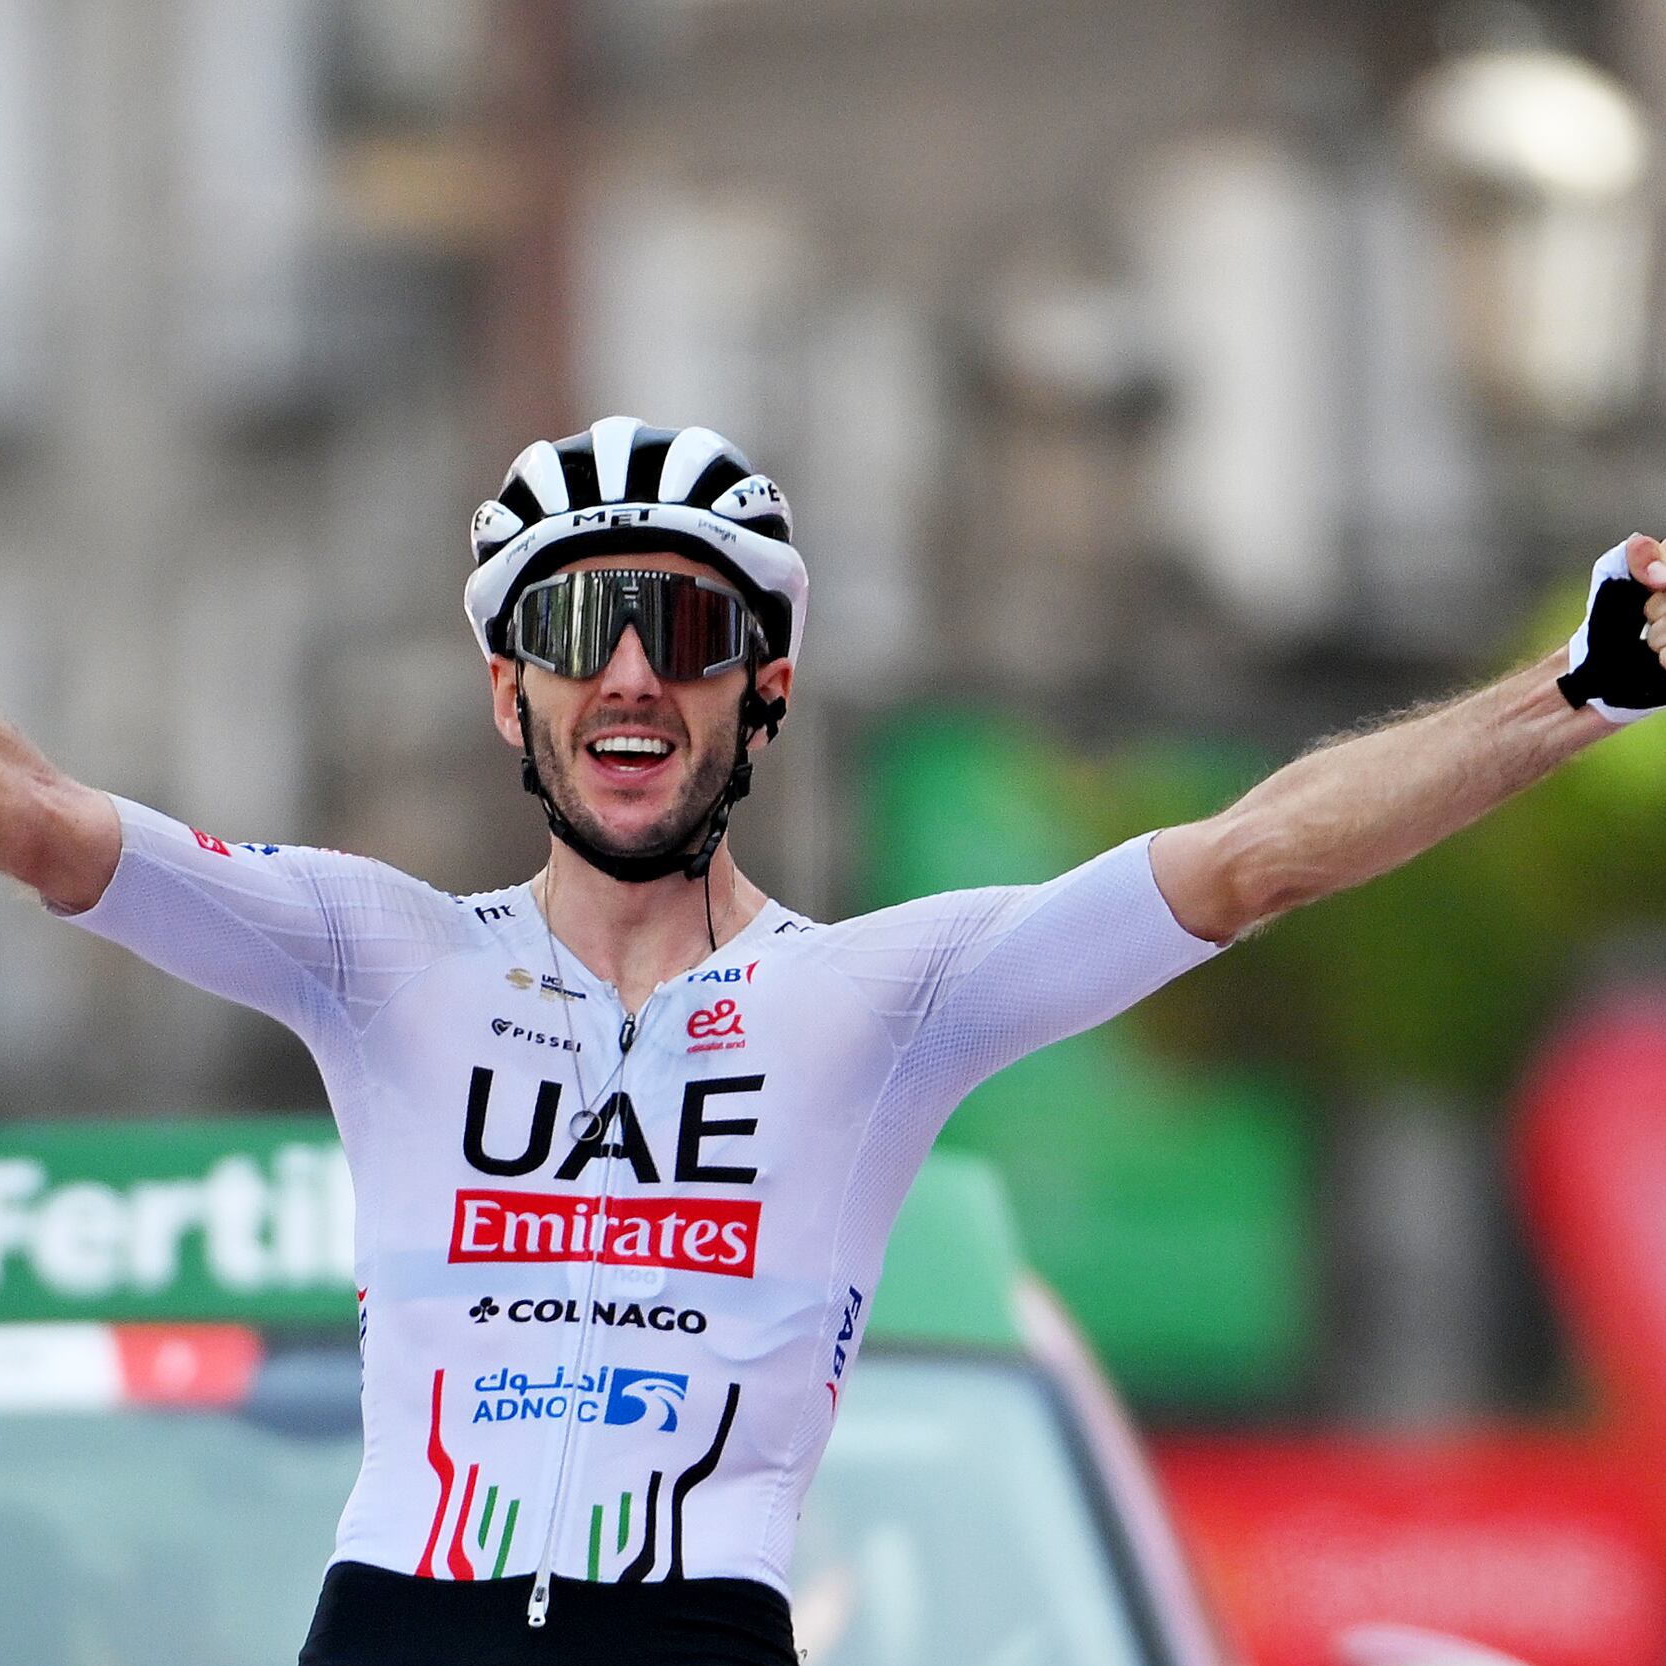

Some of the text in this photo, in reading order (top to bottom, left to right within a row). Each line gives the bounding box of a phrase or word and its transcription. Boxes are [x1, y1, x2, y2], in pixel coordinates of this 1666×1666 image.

[573, 508, 658, 528] MET
[513, 1027, 582, 1053] PISSEI
[463, 1066, 766, 1184] UAE
[460, 1199, 749, 1266] Emirates
[507, 1299, 707, 1335] COLNAGO
[832, 1284, 863, 1380] FAB
[472, 1395, 599, 1424] ADNOC
